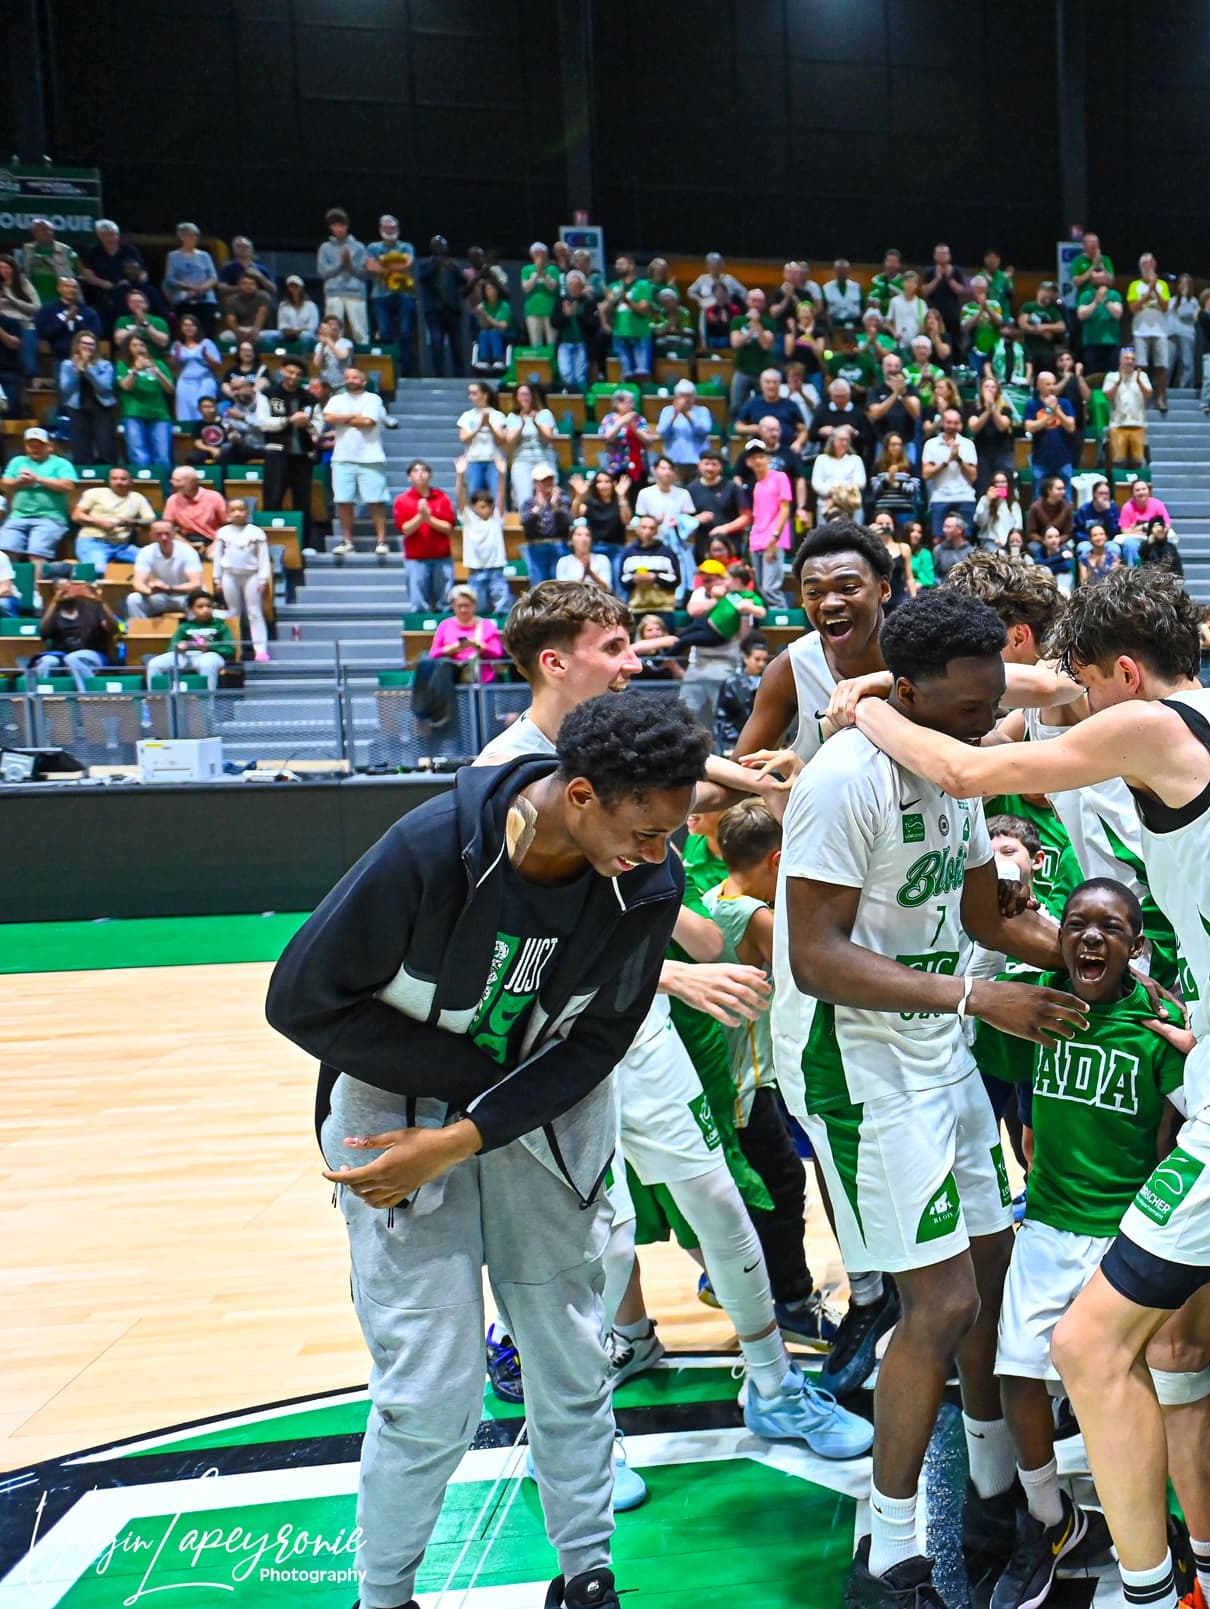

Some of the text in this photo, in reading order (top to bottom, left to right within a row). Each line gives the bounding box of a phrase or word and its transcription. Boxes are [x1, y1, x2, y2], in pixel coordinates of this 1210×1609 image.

[897, 846, 967, 908] Bloi
[930, 904, 946, 948] 7
[504, 937, 559, 993] JUST
[1033, 1038, 1139, 1115] ADA
